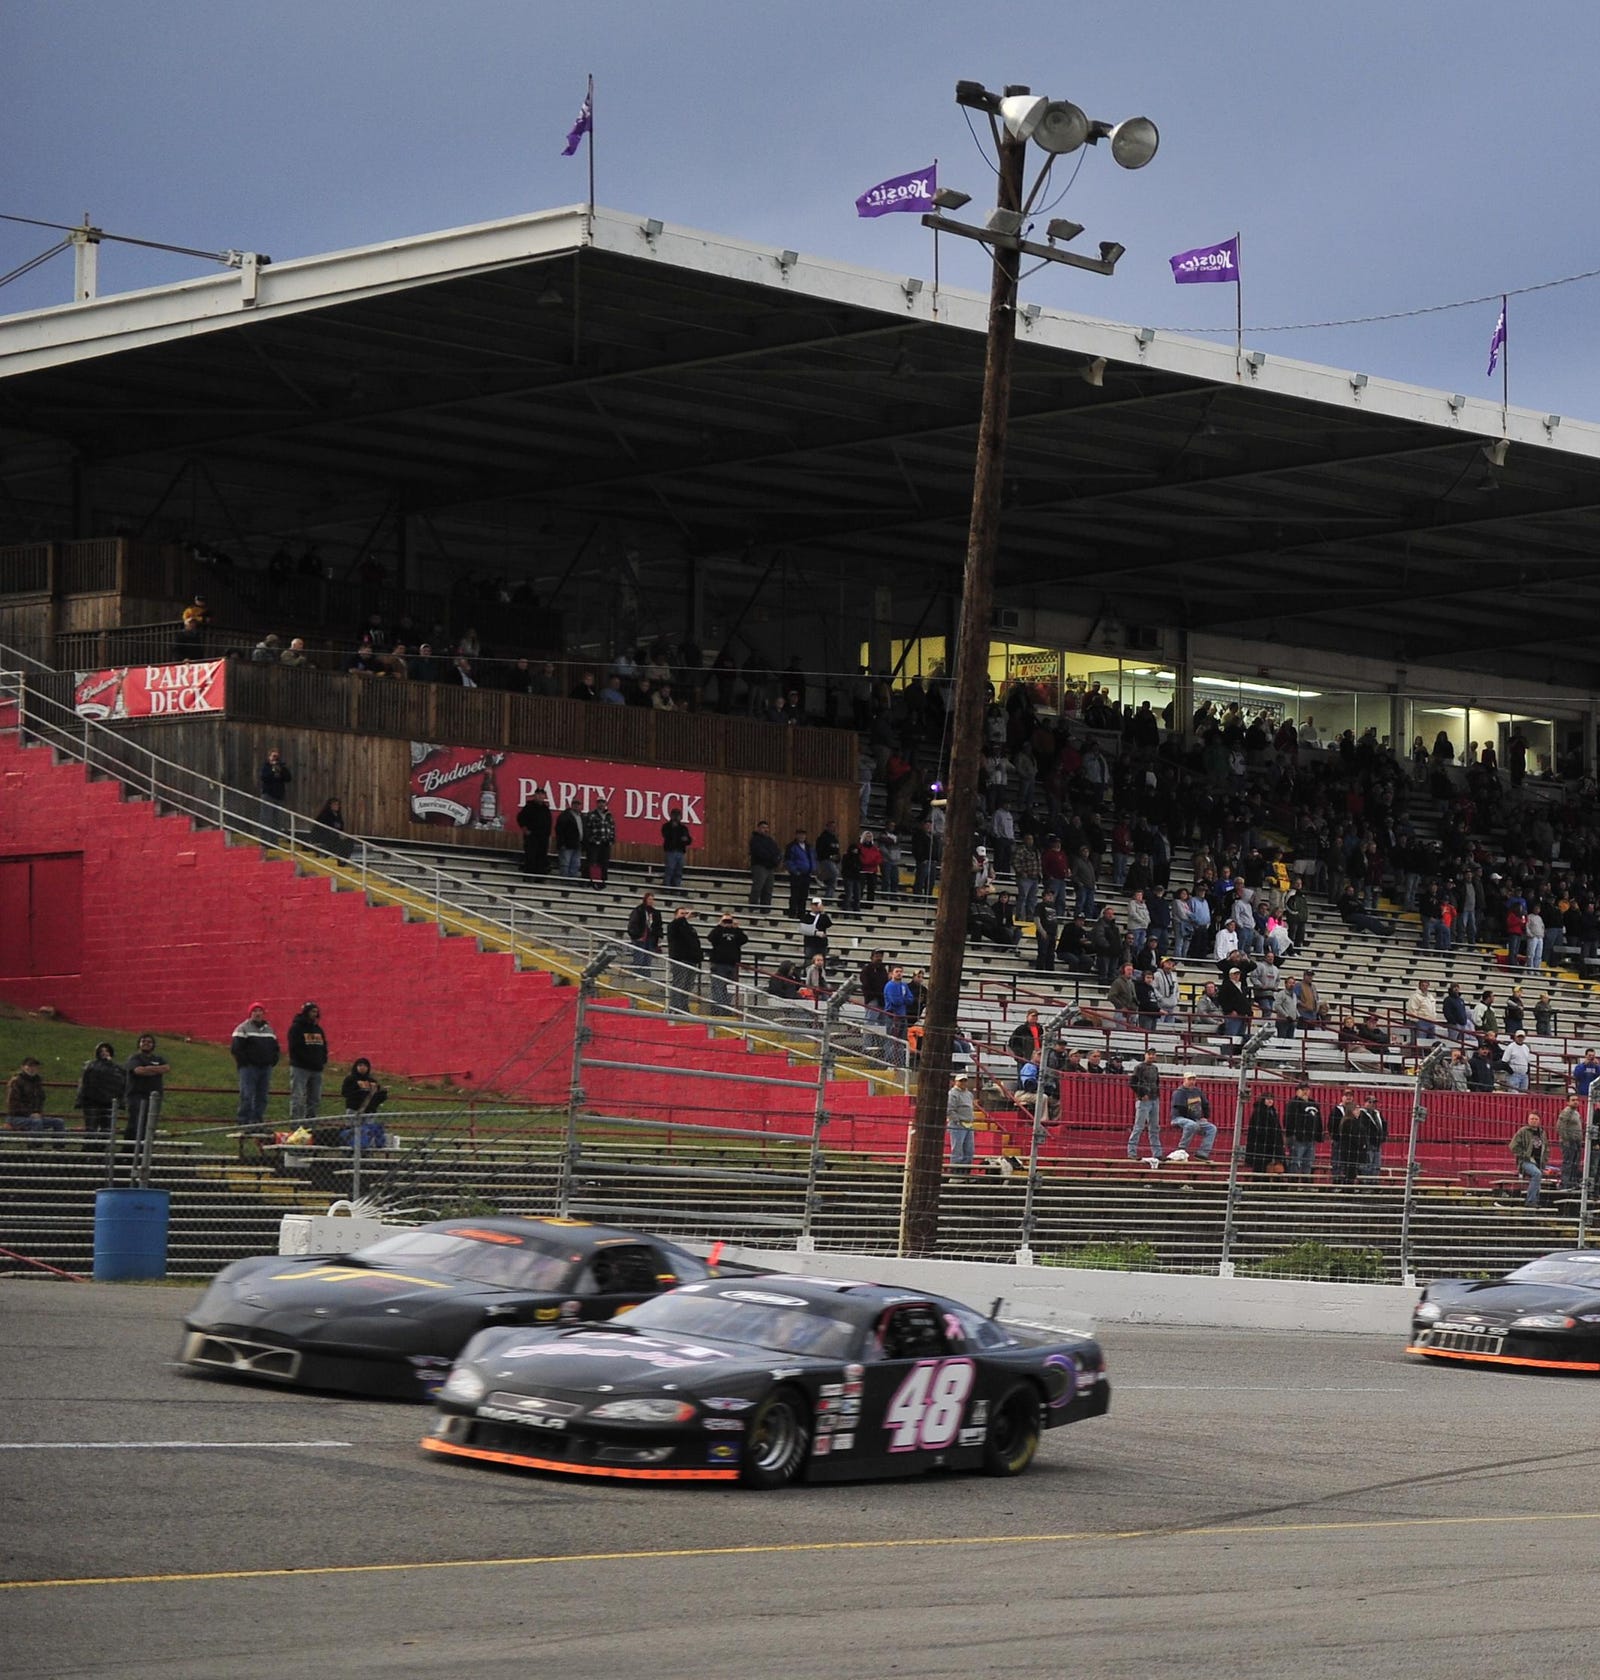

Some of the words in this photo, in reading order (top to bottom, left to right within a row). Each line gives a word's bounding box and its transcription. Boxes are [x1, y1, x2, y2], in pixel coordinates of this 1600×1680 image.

[145, 662, 220, 690] PARTY
[149, 687, 212, 714] DECK
[418, 752, 504, 792] Budweir
[518, 778, 615, 814] PARTY
[624, 788, 702, 825] DECK
[884, 1359, 975, 1452] 48
